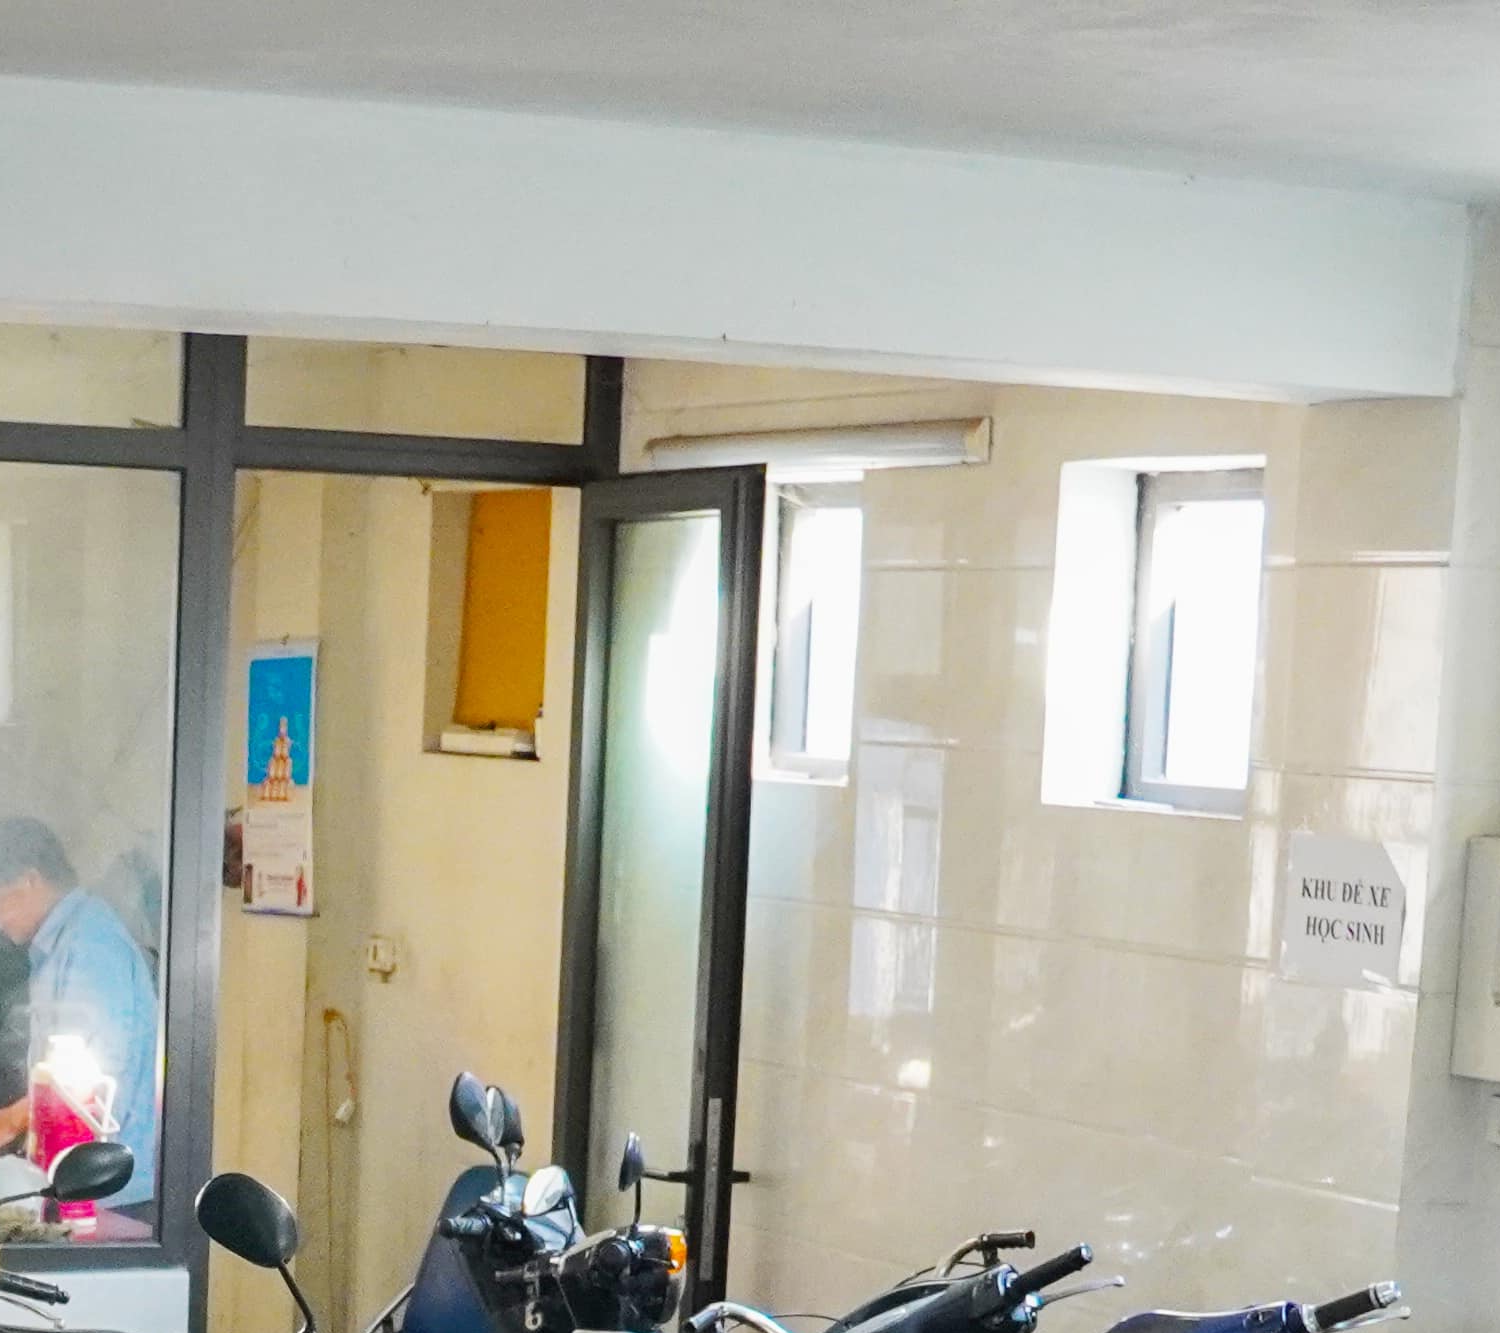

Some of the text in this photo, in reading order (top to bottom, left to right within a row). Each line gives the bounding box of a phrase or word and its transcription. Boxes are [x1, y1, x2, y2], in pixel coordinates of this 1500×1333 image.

[1302, 877, 1336, 901] KHU
[1368, 886, 1391, 907] XE
[1306, 916, 1384, 945] HỌC SINH
